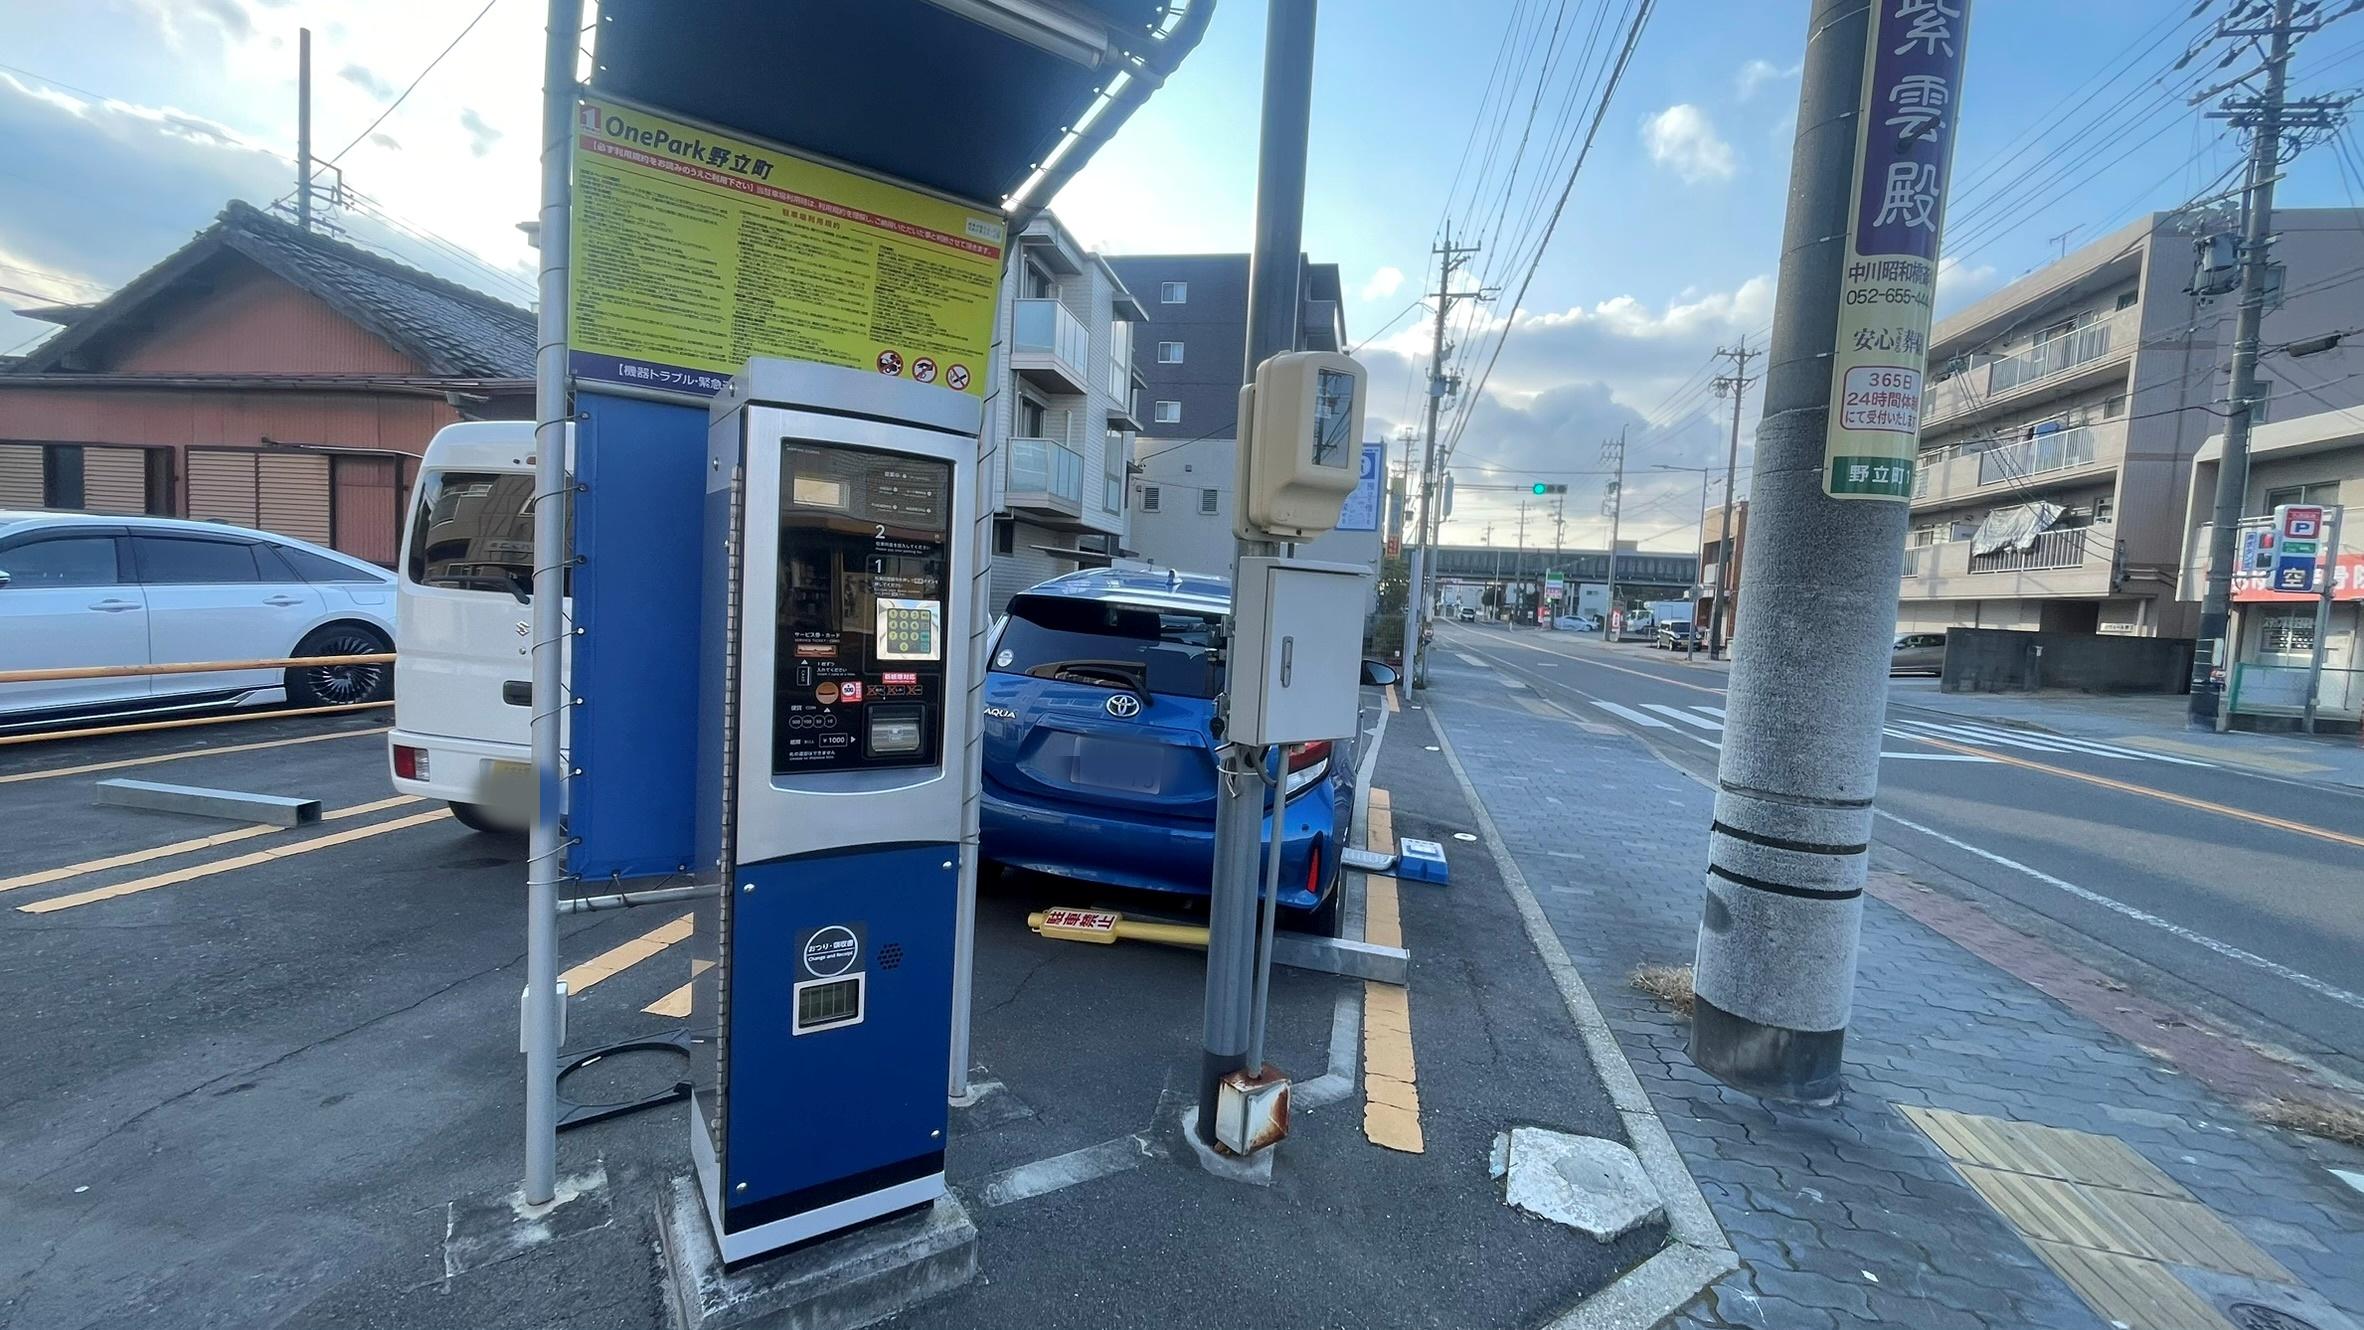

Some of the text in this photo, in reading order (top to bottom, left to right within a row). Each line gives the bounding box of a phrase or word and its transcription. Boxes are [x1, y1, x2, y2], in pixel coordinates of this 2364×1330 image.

[1873, 0, 1961, 233] 紫雲殿
[1869, 372, 1912, 389] 365日
[875, 524, 885, 539] 2
[2295, 522, 2309, 533] P
[875, 558, 882, 574] 1
[2281, 567, 2306, 588] 空
[984, 707, 1017, 719] AQUA
[1046, 911, 1115, 929] 駐車禁止
